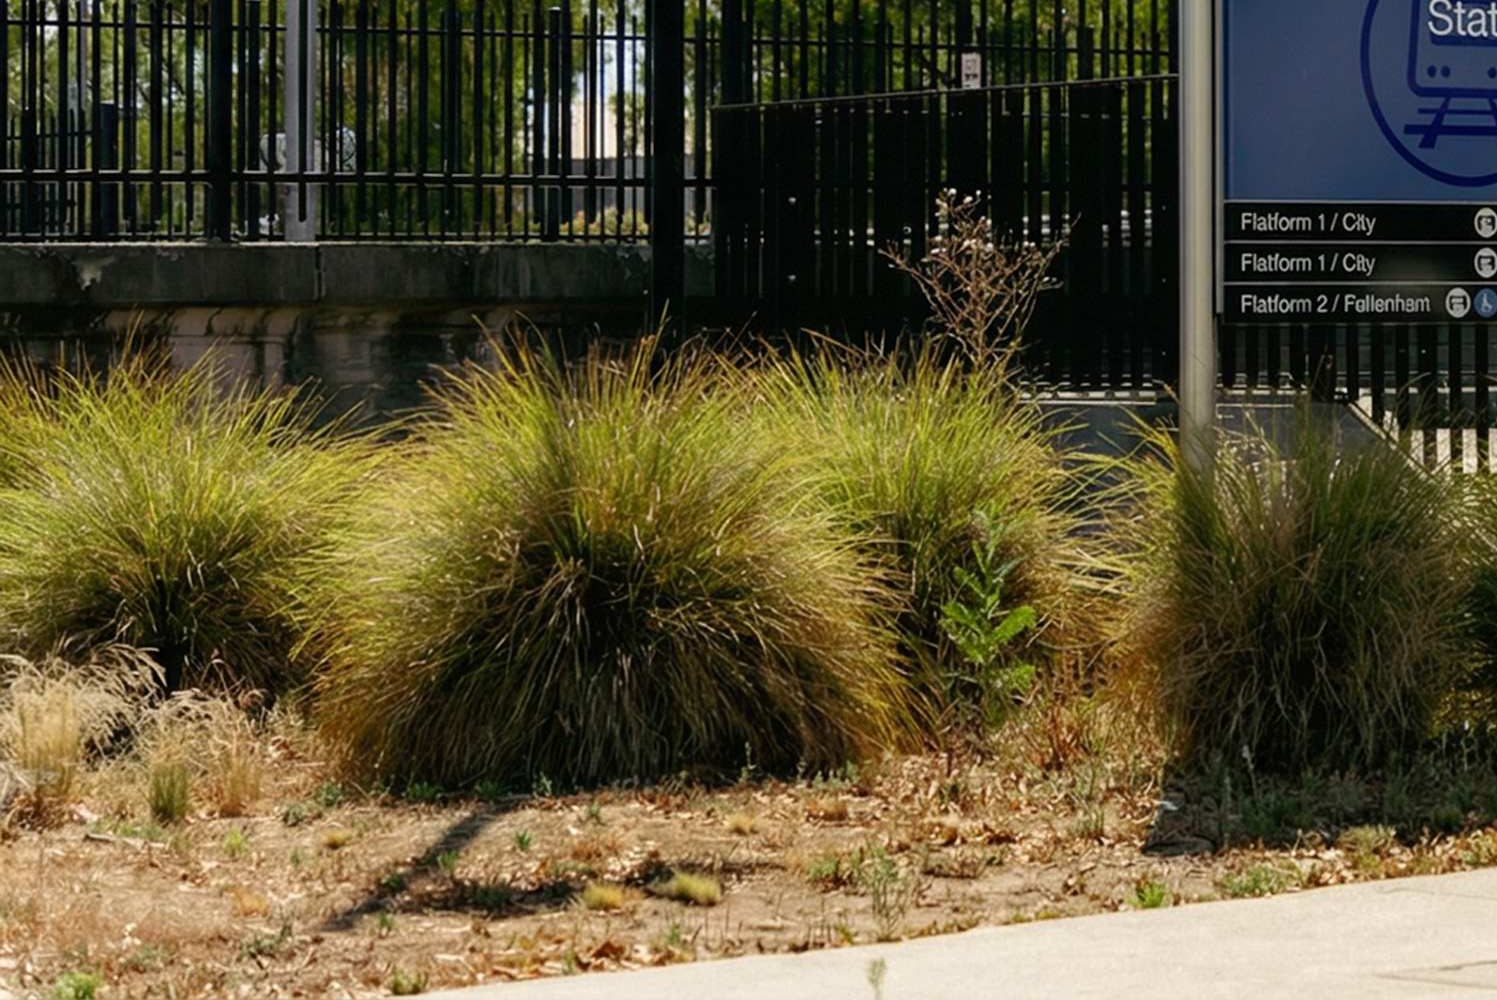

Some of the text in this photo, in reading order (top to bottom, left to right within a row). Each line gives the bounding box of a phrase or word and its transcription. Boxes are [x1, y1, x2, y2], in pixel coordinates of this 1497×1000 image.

[1317, 213, 1325, 231] 1
[1317, 254, 1325, 271] 1
[1316, 294, 1328, 313] 2
